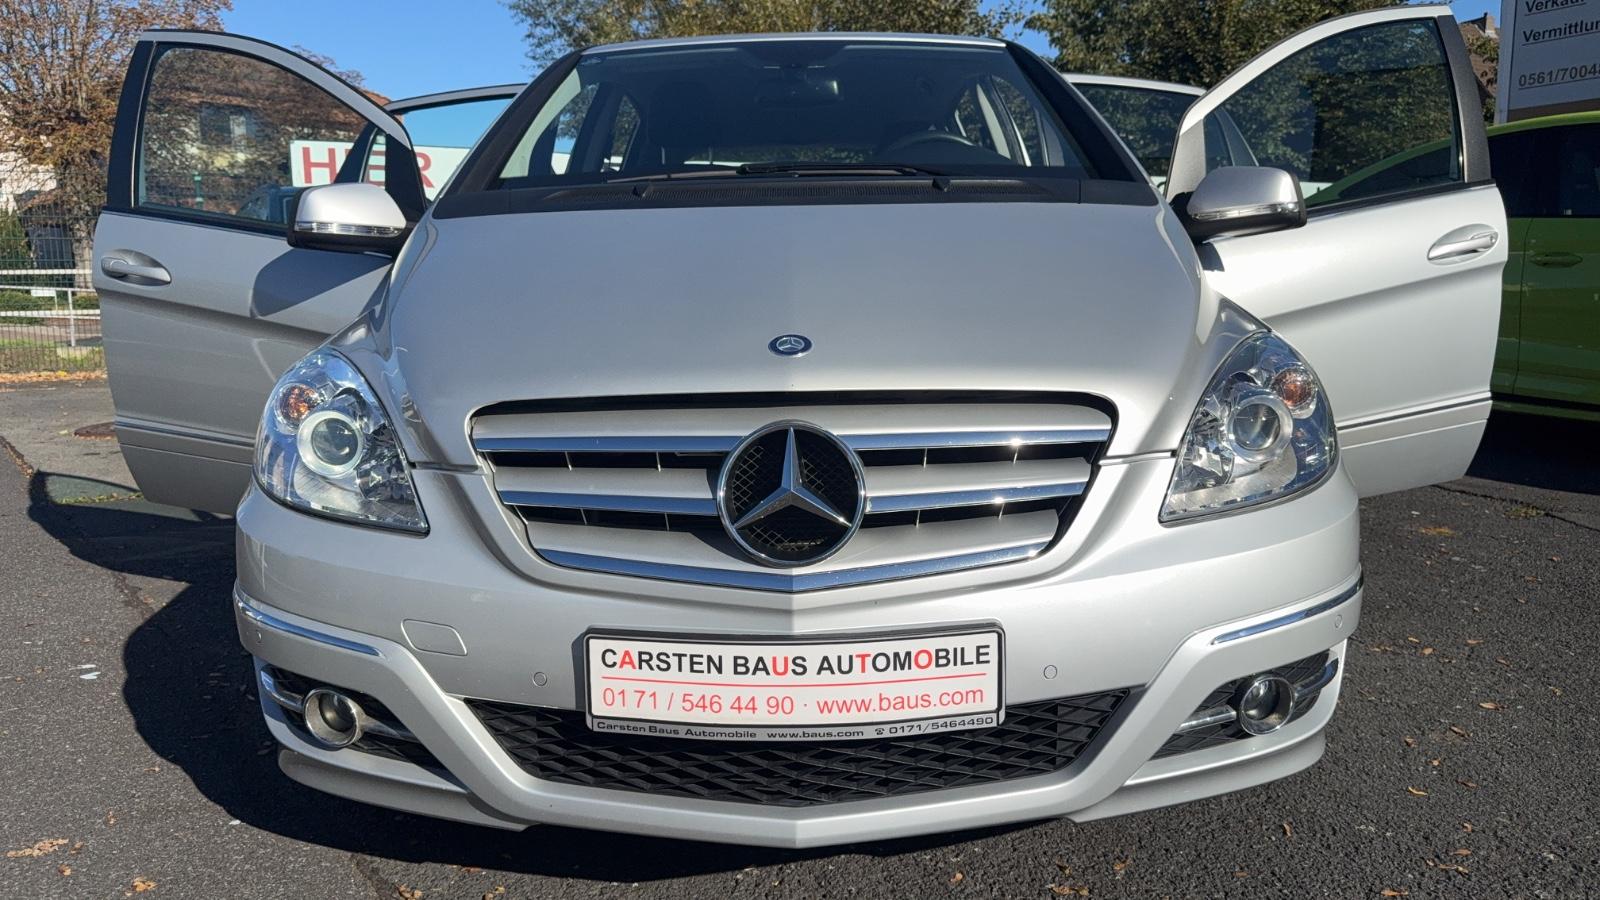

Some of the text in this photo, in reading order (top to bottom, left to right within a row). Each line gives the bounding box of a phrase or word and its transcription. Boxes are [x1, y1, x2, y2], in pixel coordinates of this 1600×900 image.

[1525, 0, 1585, 13] Verka
[1518, 63, 1600, 87] 0561/7004
[302, 146, 434, 188] HER
[601, 644, 991, 676] CARSTEN BAUS AUTOMOBILE
[681, 693, 722, 714] 546
[729, 695, 758, 714] 44
[766, 696, 794, 715] 90
[816, 688, 984, 715] www.baus.com
[597, 716, 994, 739] Carsten Baus Automobile www.baus.com 0171/5464490
